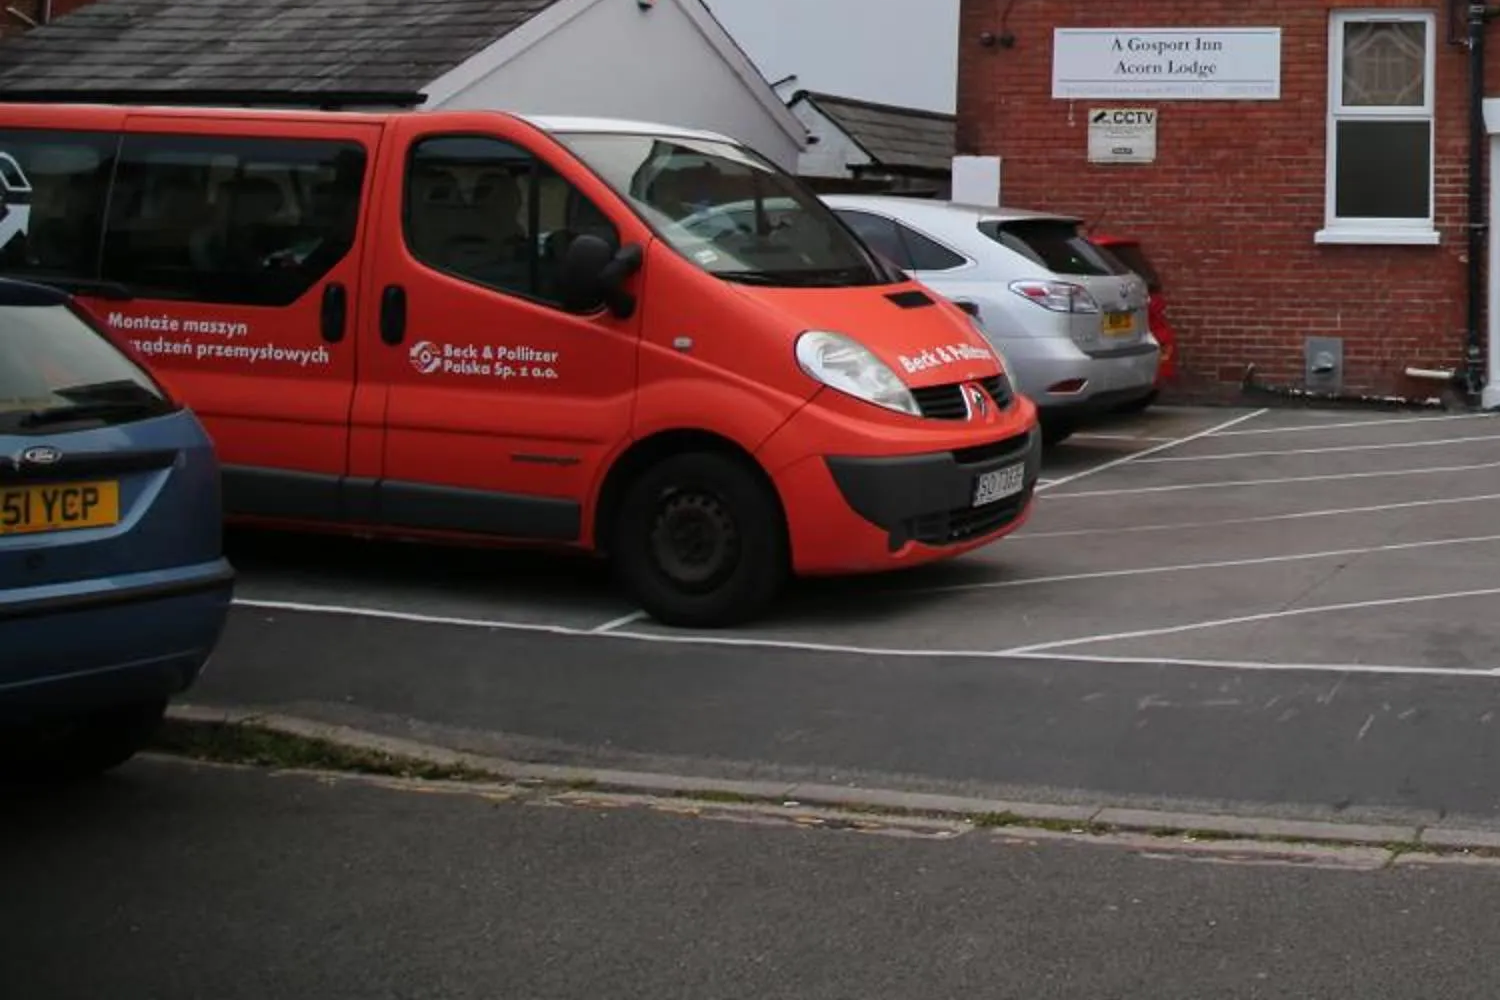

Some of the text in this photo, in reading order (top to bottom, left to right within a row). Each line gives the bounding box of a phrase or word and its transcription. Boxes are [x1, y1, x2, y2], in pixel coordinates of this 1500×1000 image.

[1111, 37, 1223, 55] A Gosport Inn
[1114, 60, 1217, 78] Acorn Lodge
[1113, 111, 1153, 124] CCTV
[108, 312, 248, 338] Montaże maszyn
[197, 343, 329, 366] przemysłowych
[444, 344, 558, 362] Beck & Pollitzer
[897, 349, 943, 373] Beck
[444, 360, 491, 375] Polska
[494, 361, 516, 379] Sp.
[42, 488, 99, 522] YCP
